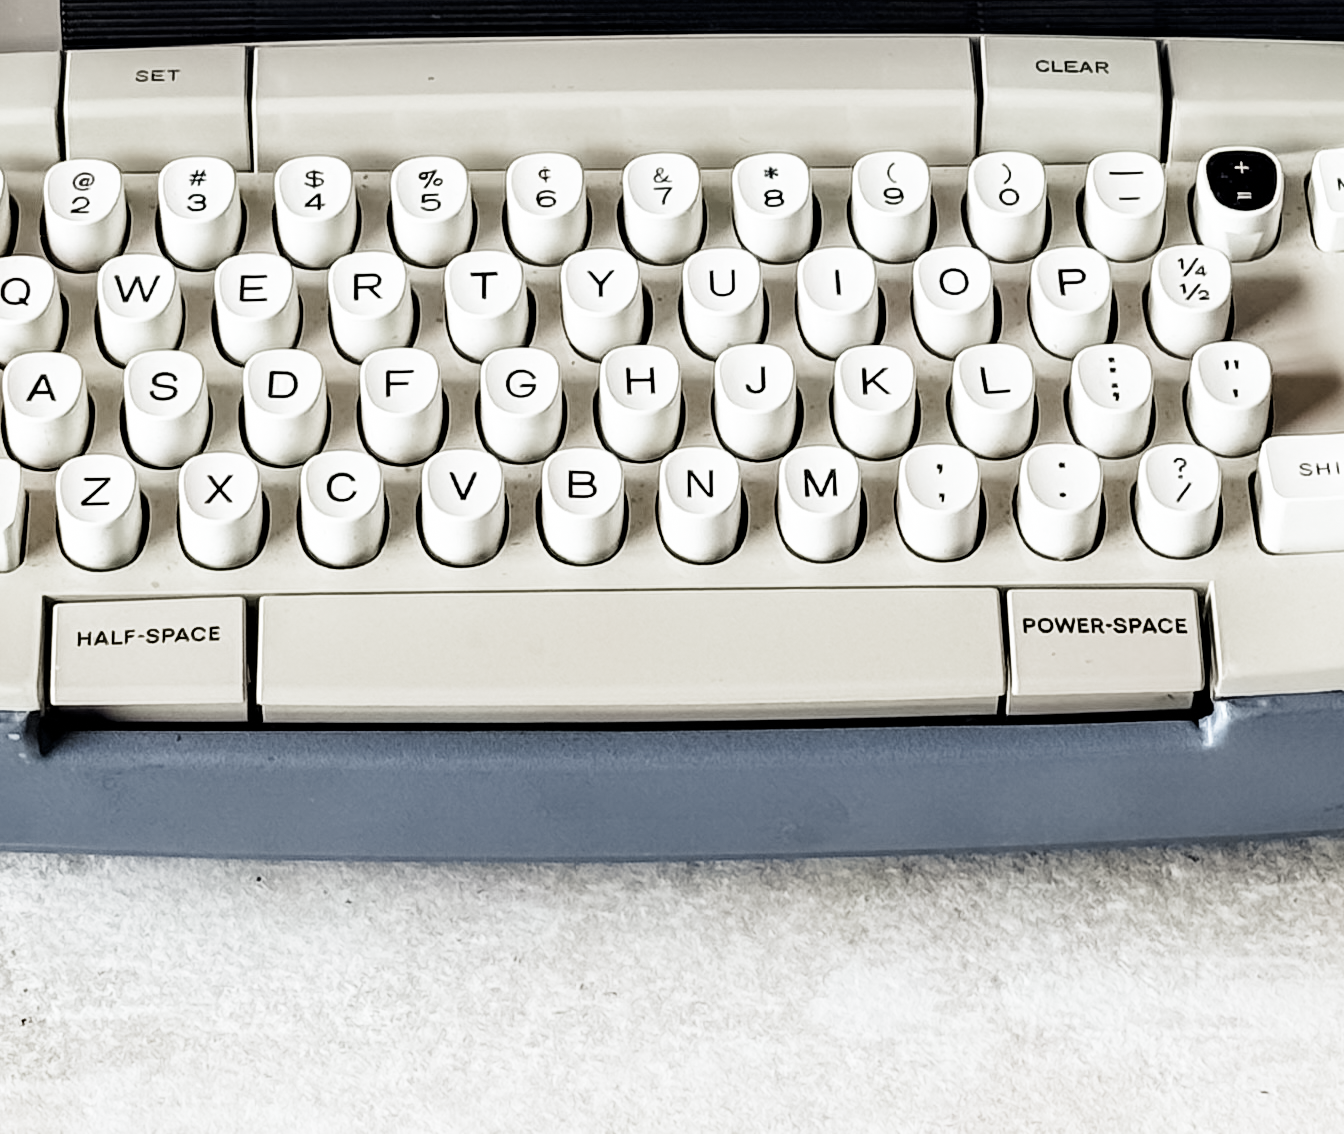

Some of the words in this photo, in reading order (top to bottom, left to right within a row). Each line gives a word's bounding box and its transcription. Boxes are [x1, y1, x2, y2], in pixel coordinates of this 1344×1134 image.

[135, 69, 180, 83] SET
[1035, 59, 1109, 74] CLEAR
[72, 172, 95, 192] @
[189, 169, 207, 187] #
[304, 170, 325, 189] $
[418, 169, 444, 189] %
[653, 167, 671, 183] &
[70, 196, 90, 214] 2
[187, 193, 207, 212] 3
[304, 193, 325, 211] 4
[421, 193, 442, 212] 5
[535, 189, 557, 208] 6
[653, 186, 673, 205] 7
[763, 189, 785, 208] 8
[883, 187, 905, 205] 9
[0, 277, 31, 306] Q
[114, 274, 161, 303] W
[239, 274, 268, 302] E
[353, 273, 382, 301] R
[470, 271, 499, 300] T
[587, 269, 615, 298] Y
[709, 269, 736, 297] U
[834, 269, 842, 296] I
[939, 267, 970, 296] O
[1057, 268, 1087, 296] P
[26, 374, 56, 402] A
[149, 371, 178, 401] S
[267, 370, 299, 399] D
[385, 369, 415, 398] F
[505, 369, 537, 399] G
[625, 367, 656, 395] H
[745, 366, 766, 394] J
[861, 367, 890, 395] K
[980, 366, 1011, 395] L
[1173, 457, 1187, 479] ?
[80, 477, 111, 507] Z
[204, 474, 233, 504] X
[326, 472, 357, 503] C
[449, 471, 477, 501] V
[568, 470, 598, 499] B
[687, 469, 714, 498] N
[803, 468, 838, 498] M
[77, 625, 220, 647] HALF-SPACE
[1022, 617, 1188, 634] POWER-SPACE
